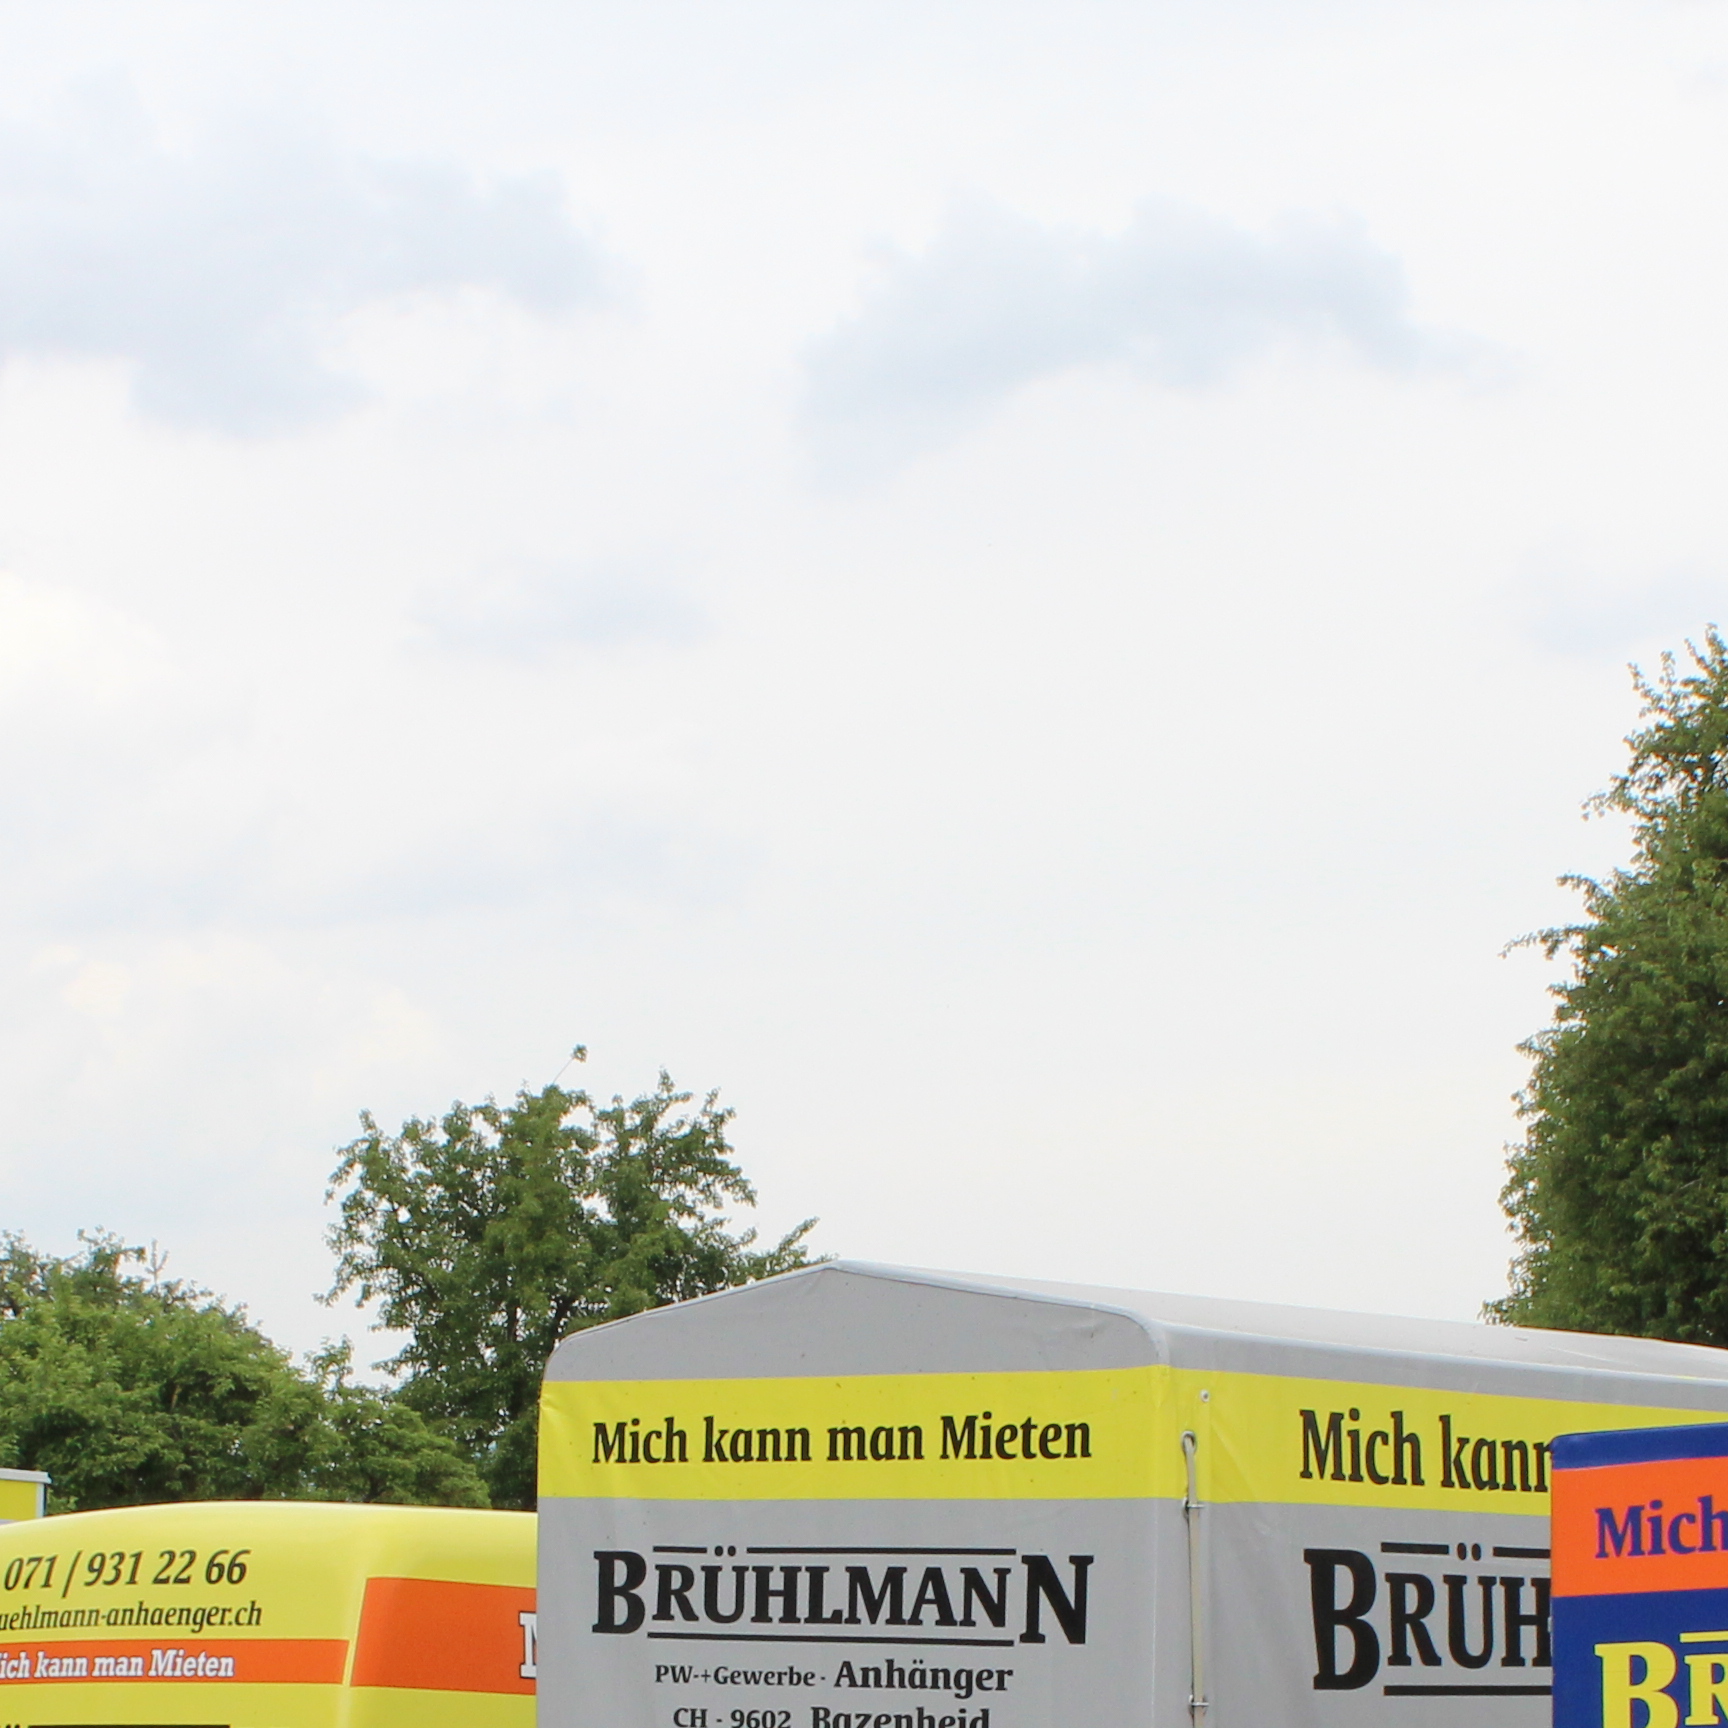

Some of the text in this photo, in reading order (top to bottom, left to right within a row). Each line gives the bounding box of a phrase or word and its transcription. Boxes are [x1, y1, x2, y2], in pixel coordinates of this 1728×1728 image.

[592, 1411, 1092, 1464] Mich kann man Mieten
[1299, 1408, 1425, 1486] Mich
[3, 1549, 251, 1591] 071 931 22 66
[591, 1545, 1094, 1645] BRÜHLMANN
[34, 1652, 88, 1678] kann
[91, 1655, 143, 1677] man
[148, 1648, 235, 1677] Mieten
[833, 1659, 1014, 1700] Anhänger
